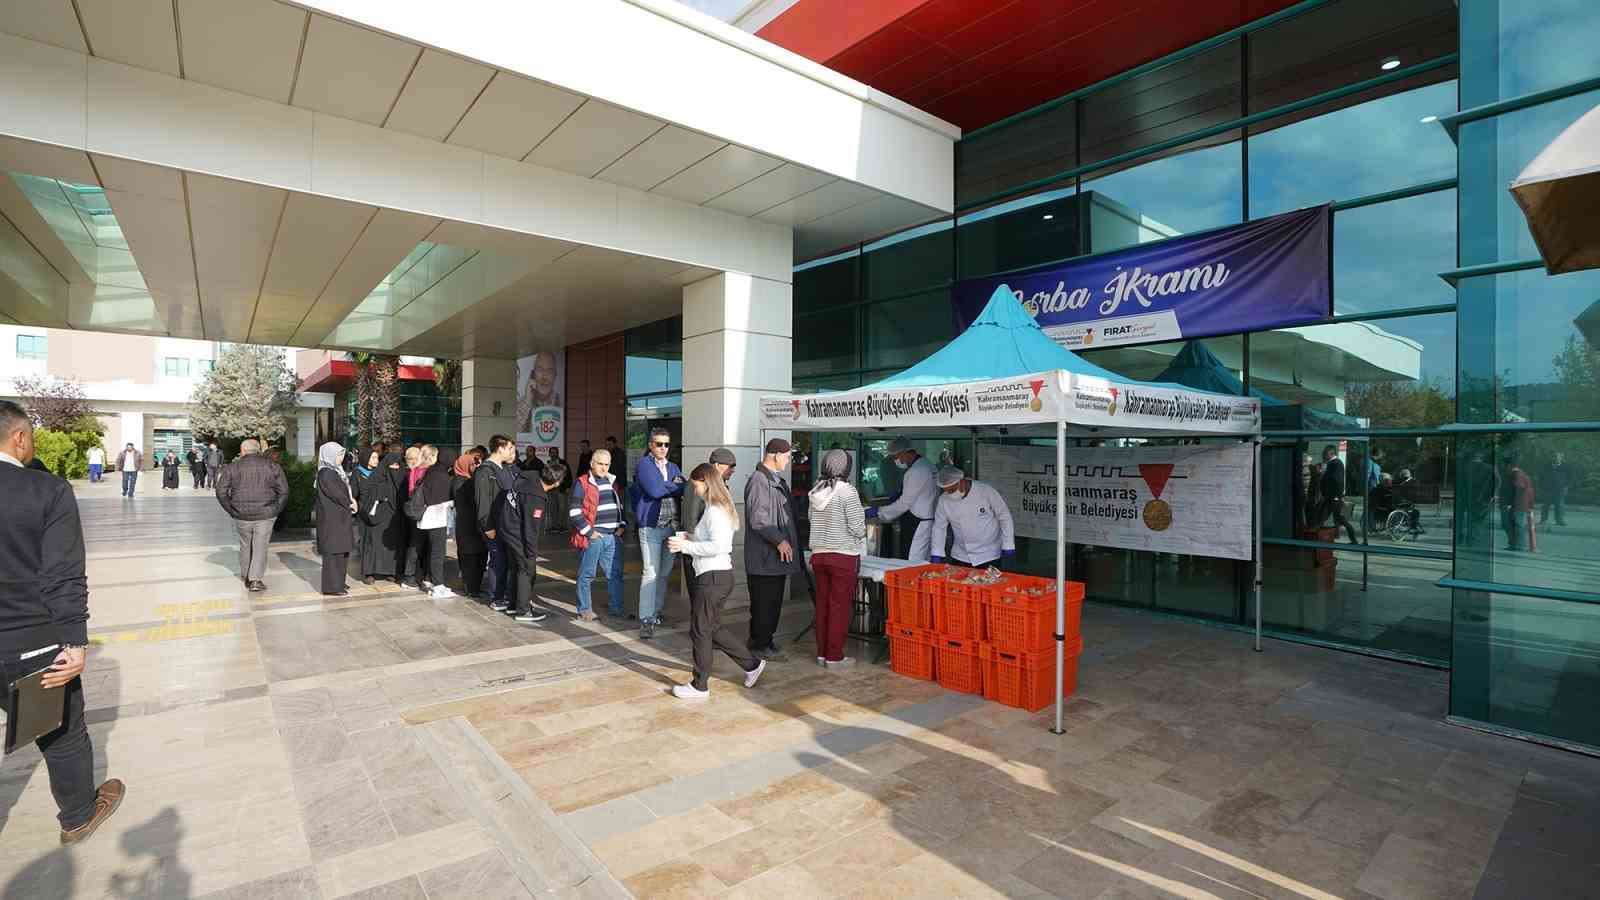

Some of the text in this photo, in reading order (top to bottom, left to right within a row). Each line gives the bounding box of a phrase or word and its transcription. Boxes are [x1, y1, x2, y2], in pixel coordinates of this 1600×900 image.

[1103, 325, 1131, 336] FIRAT
[806, 388, 970, 421] Kahramanmaraş Büyükşehir Belediyesi
[540, 420, 554, 433] 182
[1080, 502, 1138, 520] Belediyesi
